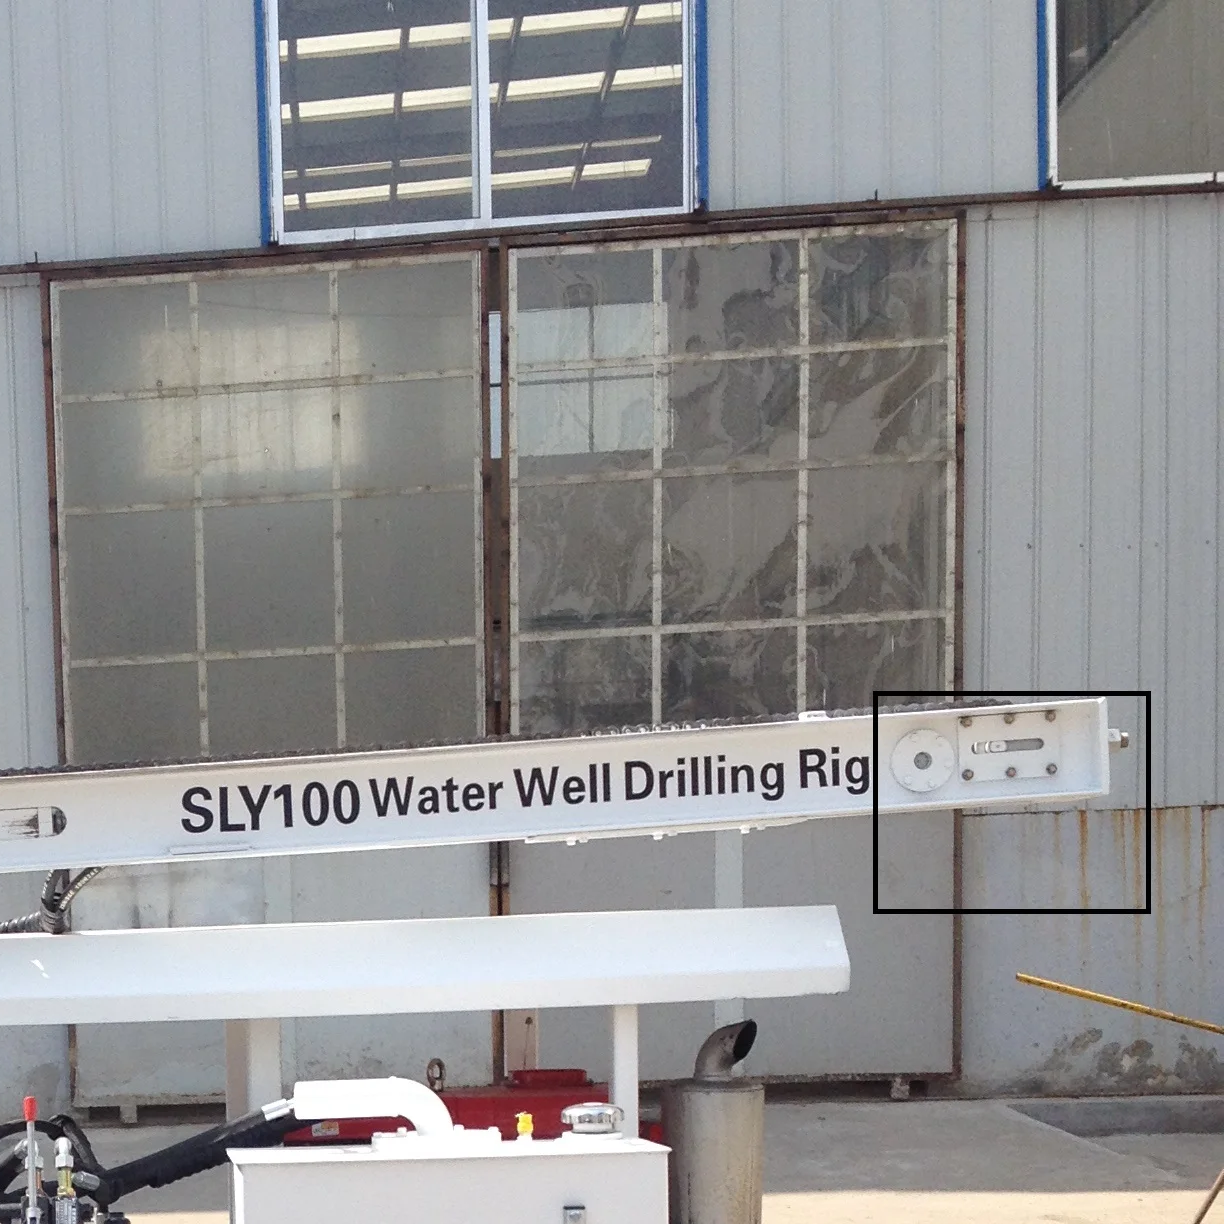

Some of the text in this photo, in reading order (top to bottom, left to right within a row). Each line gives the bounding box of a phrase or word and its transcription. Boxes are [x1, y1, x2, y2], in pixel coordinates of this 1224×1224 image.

[180, 746, 871, 835] SLY100 Water Well Drilling Rig
